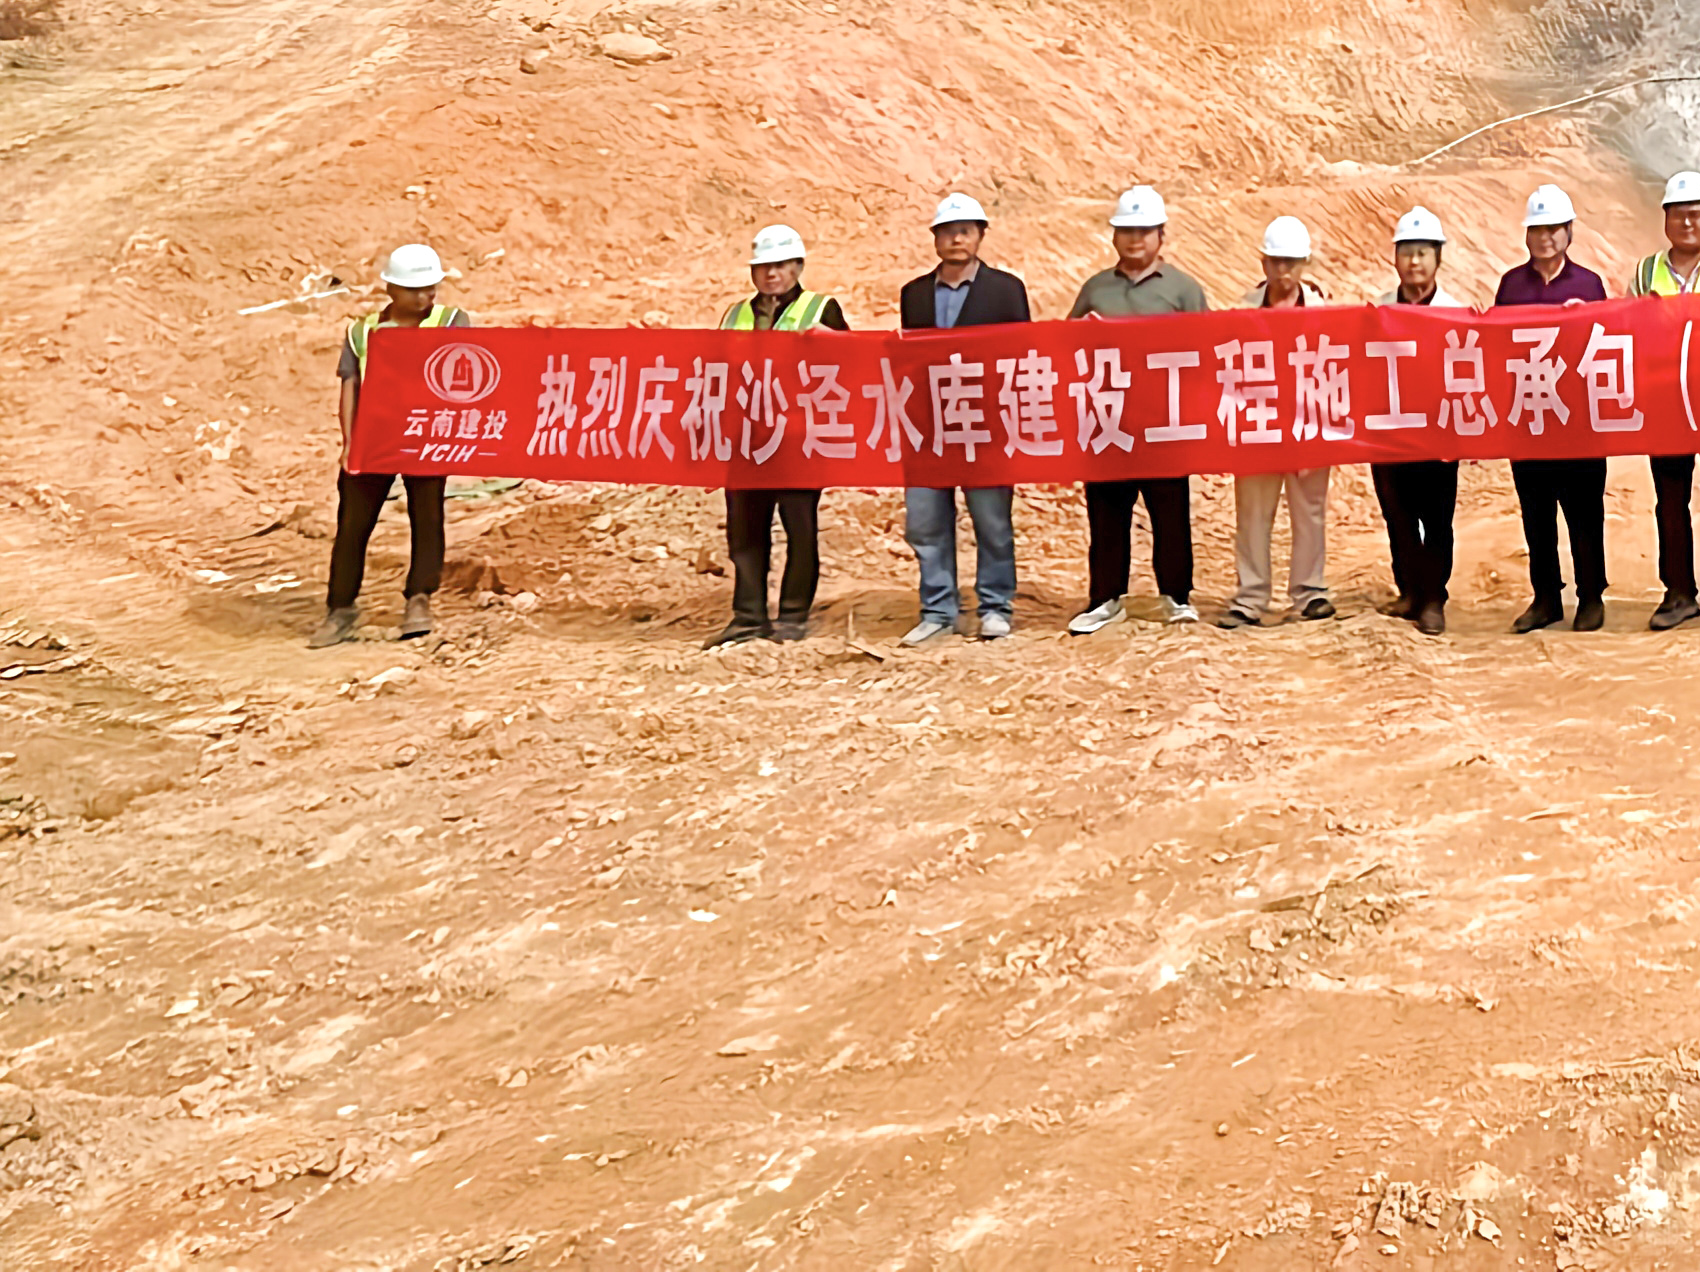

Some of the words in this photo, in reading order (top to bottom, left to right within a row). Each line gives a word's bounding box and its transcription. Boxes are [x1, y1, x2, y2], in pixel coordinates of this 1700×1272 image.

[403, 408, 508, 440] 云南建投
[419, 443, 478, 462] YCIH
